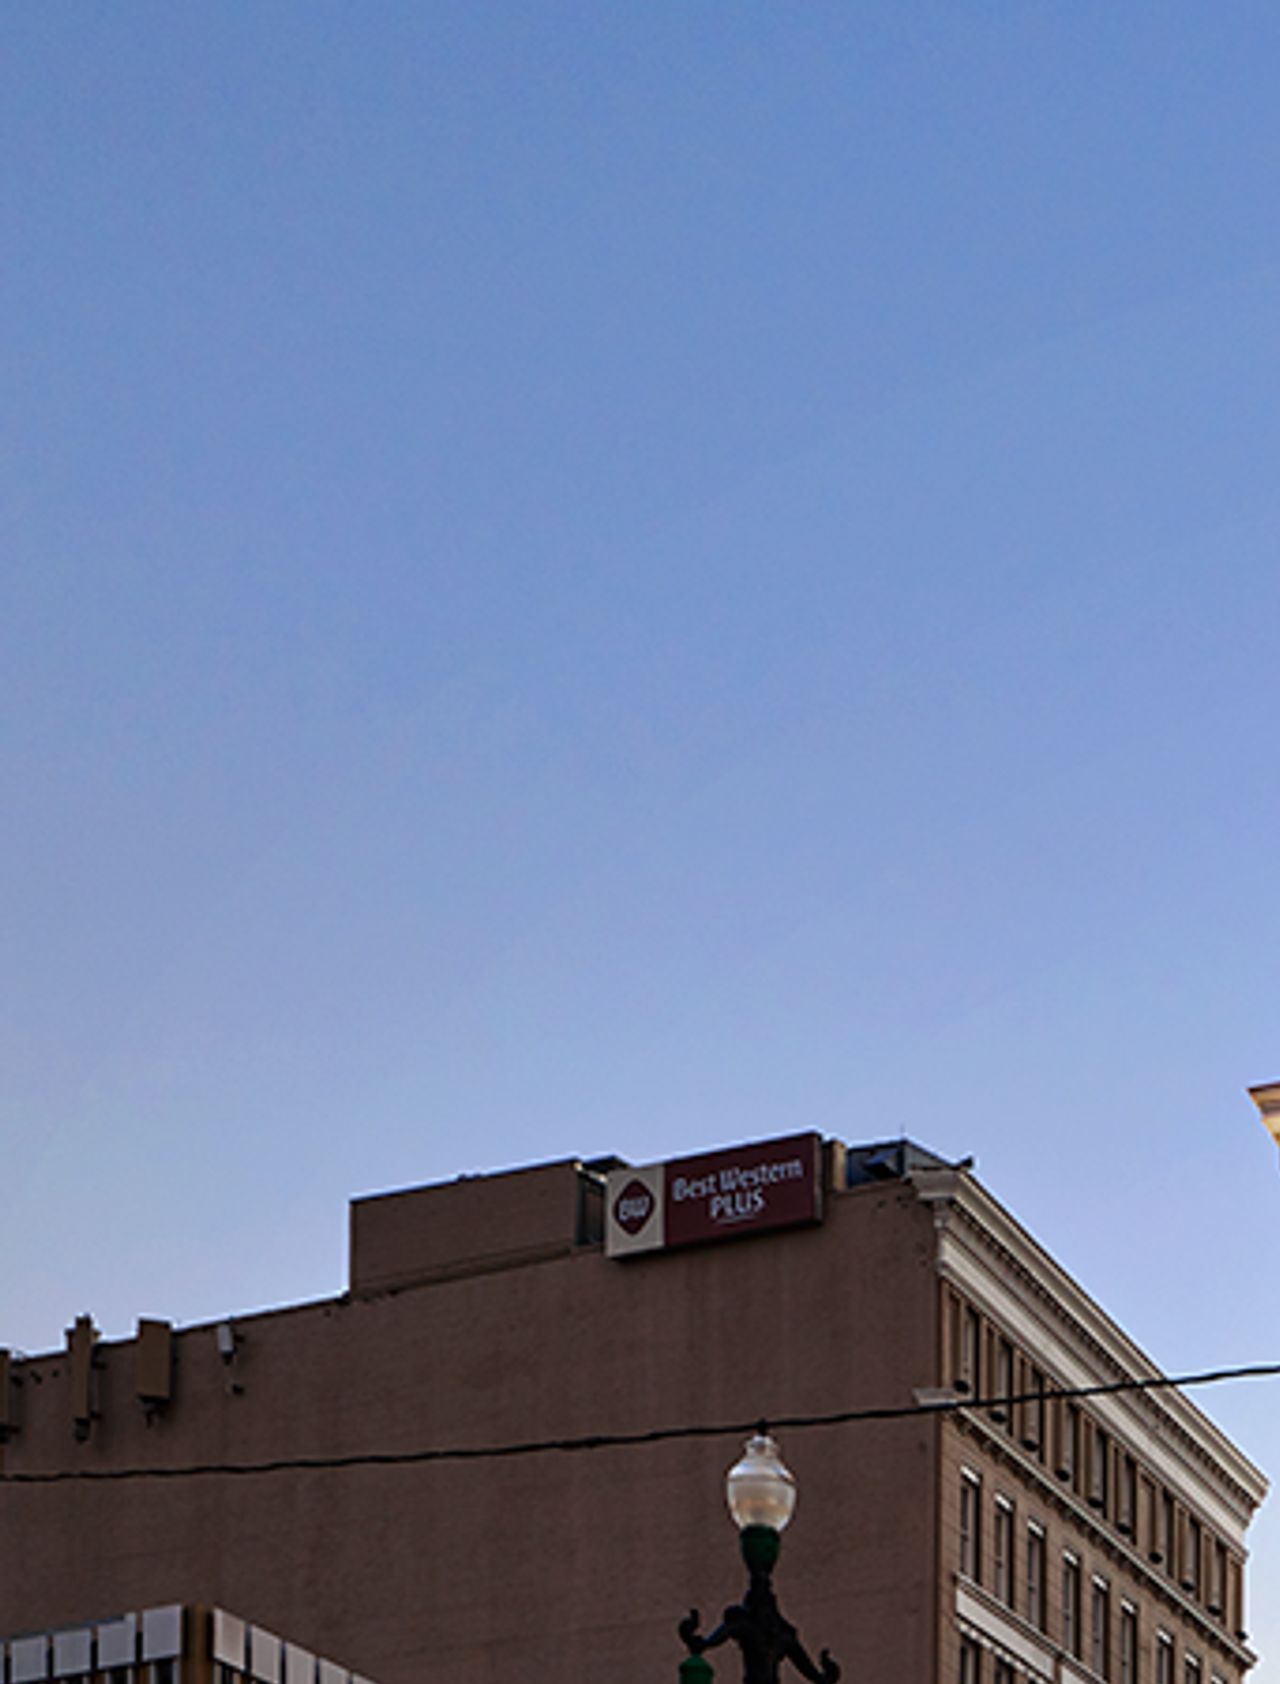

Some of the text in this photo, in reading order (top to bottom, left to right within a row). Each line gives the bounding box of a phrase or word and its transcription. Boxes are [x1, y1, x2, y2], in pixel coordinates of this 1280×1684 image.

[672, 1160, 804, 1201] Best Western
[710, 1189, 764, 1219] PLUS
